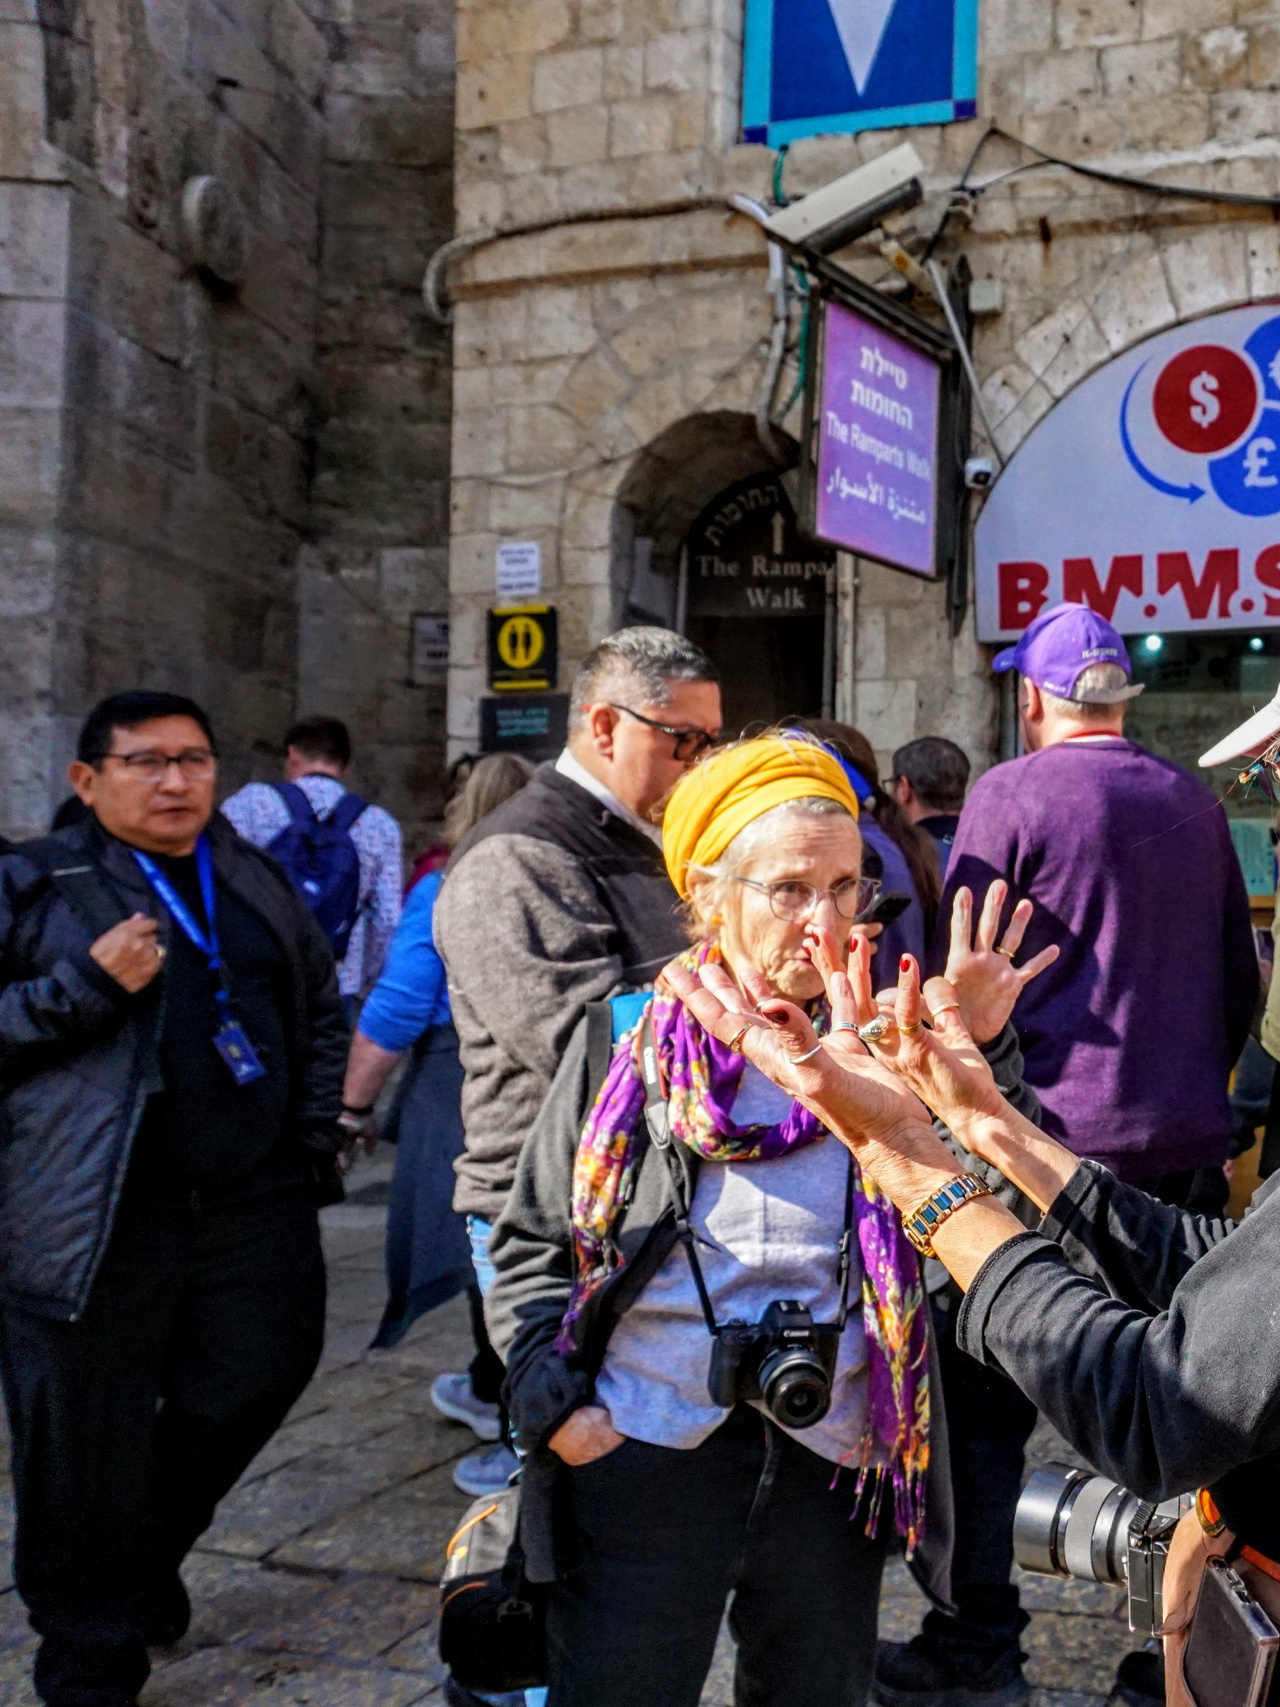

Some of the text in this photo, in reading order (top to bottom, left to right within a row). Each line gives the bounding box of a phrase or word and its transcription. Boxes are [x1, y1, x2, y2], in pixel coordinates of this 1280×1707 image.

[860, 346, 909, 390] טיילת
[850, 379, 914, 430] החומות
[826, 411, 932, 480] The Ramparts Walk
[696, 555, 829, 582] The Rampa
[746, 586, 805, 609] Walk
[783, 1329, 811, 1338] Canon
